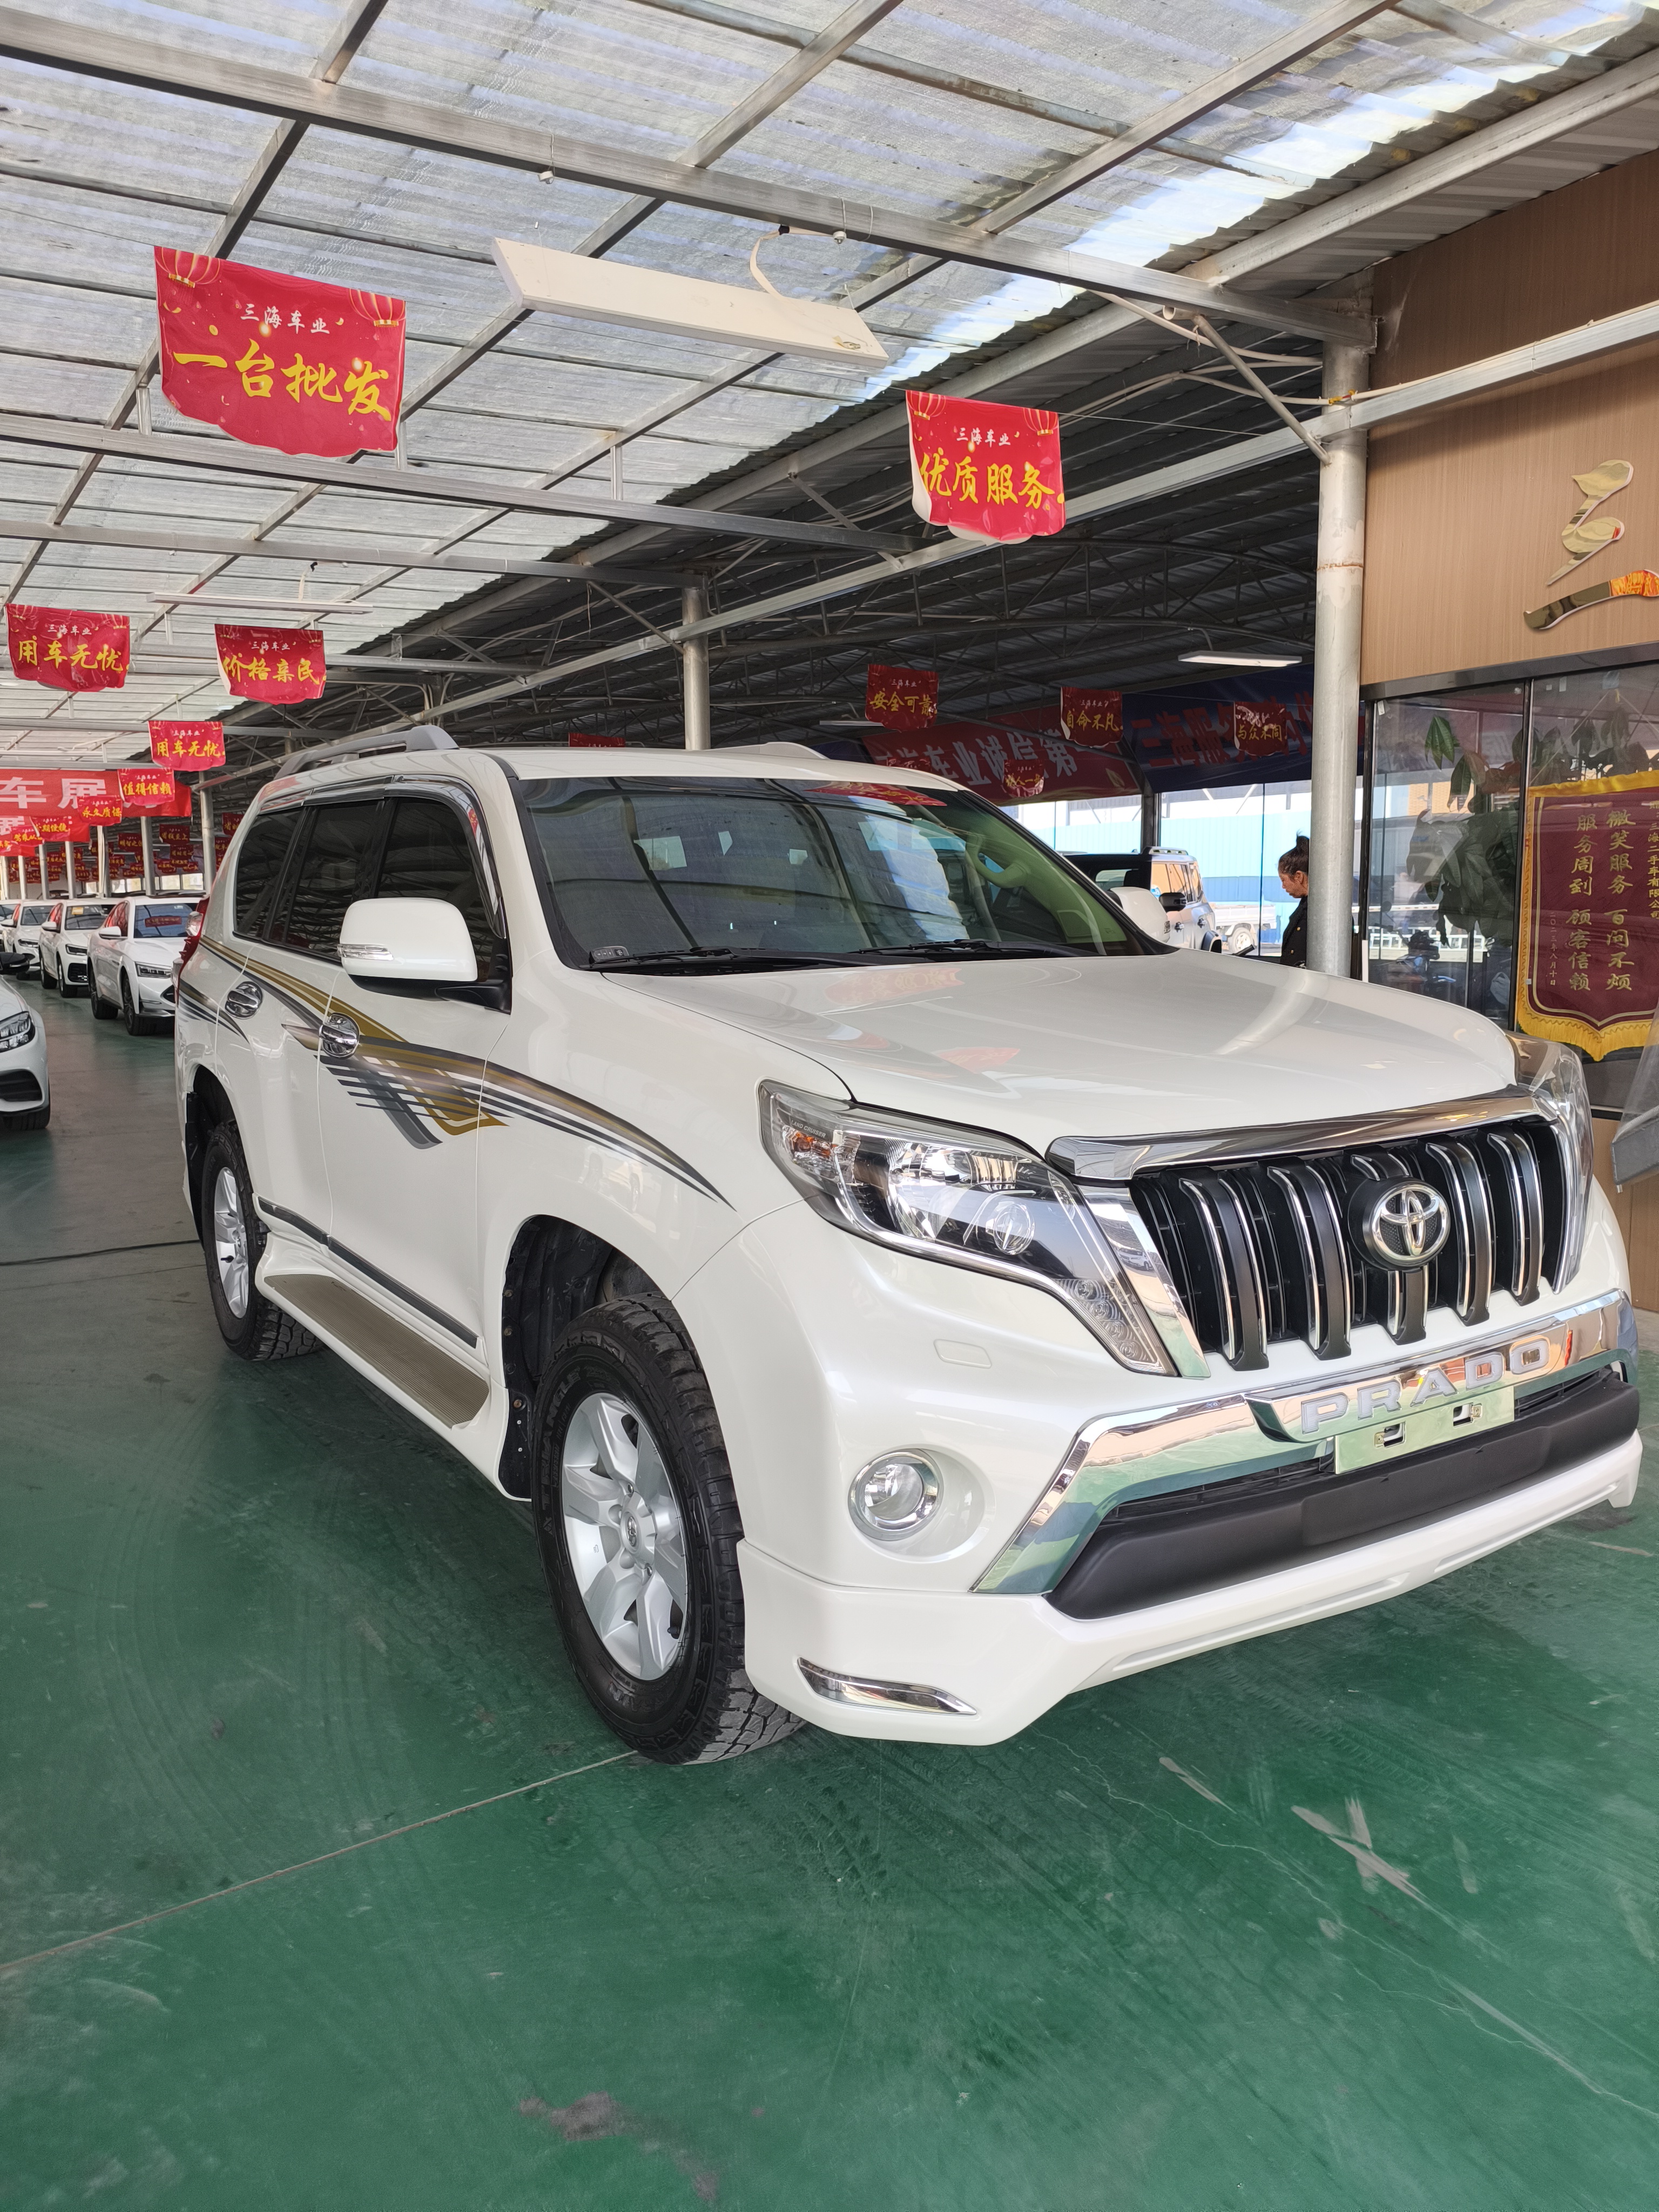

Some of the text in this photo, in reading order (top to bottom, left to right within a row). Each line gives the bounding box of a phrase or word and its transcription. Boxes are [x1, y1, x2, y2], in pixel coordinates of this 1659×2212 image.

[240, 303, 330, 335] 三海车业
[172, 339, 392, 422] 一台批发
[956, 427, 1011, 448] 三海车业
[919, 451, 1055, 509] 优质服务
[47, 624, 92, 636] 三海车业
[18, 638, 122, 672] 用车无忧
[251, 640, 292, 651] 三海车业
[222, 654, 321, 686] 价格亲民
[870, 690, 933, 717] 安全可靠
[1067, 710, 1120, 731] 自命不凡
[1237, 724, 1283, 741] 与众不同
[157, 739, 221, 758] 用车无忧
[123, 781, 172, 797] 值得信赖
[82, 806, 122, 818] 永久质保
[1566, 814, 1597, 992] 服务周到 顾客信赖
[1604, 810, 1636, 992] 微笑服务 百问不烦
[791, 1120, 826, 1138] LAND CRUISER
[1300, 1339, 1551, 1435] PRADO
